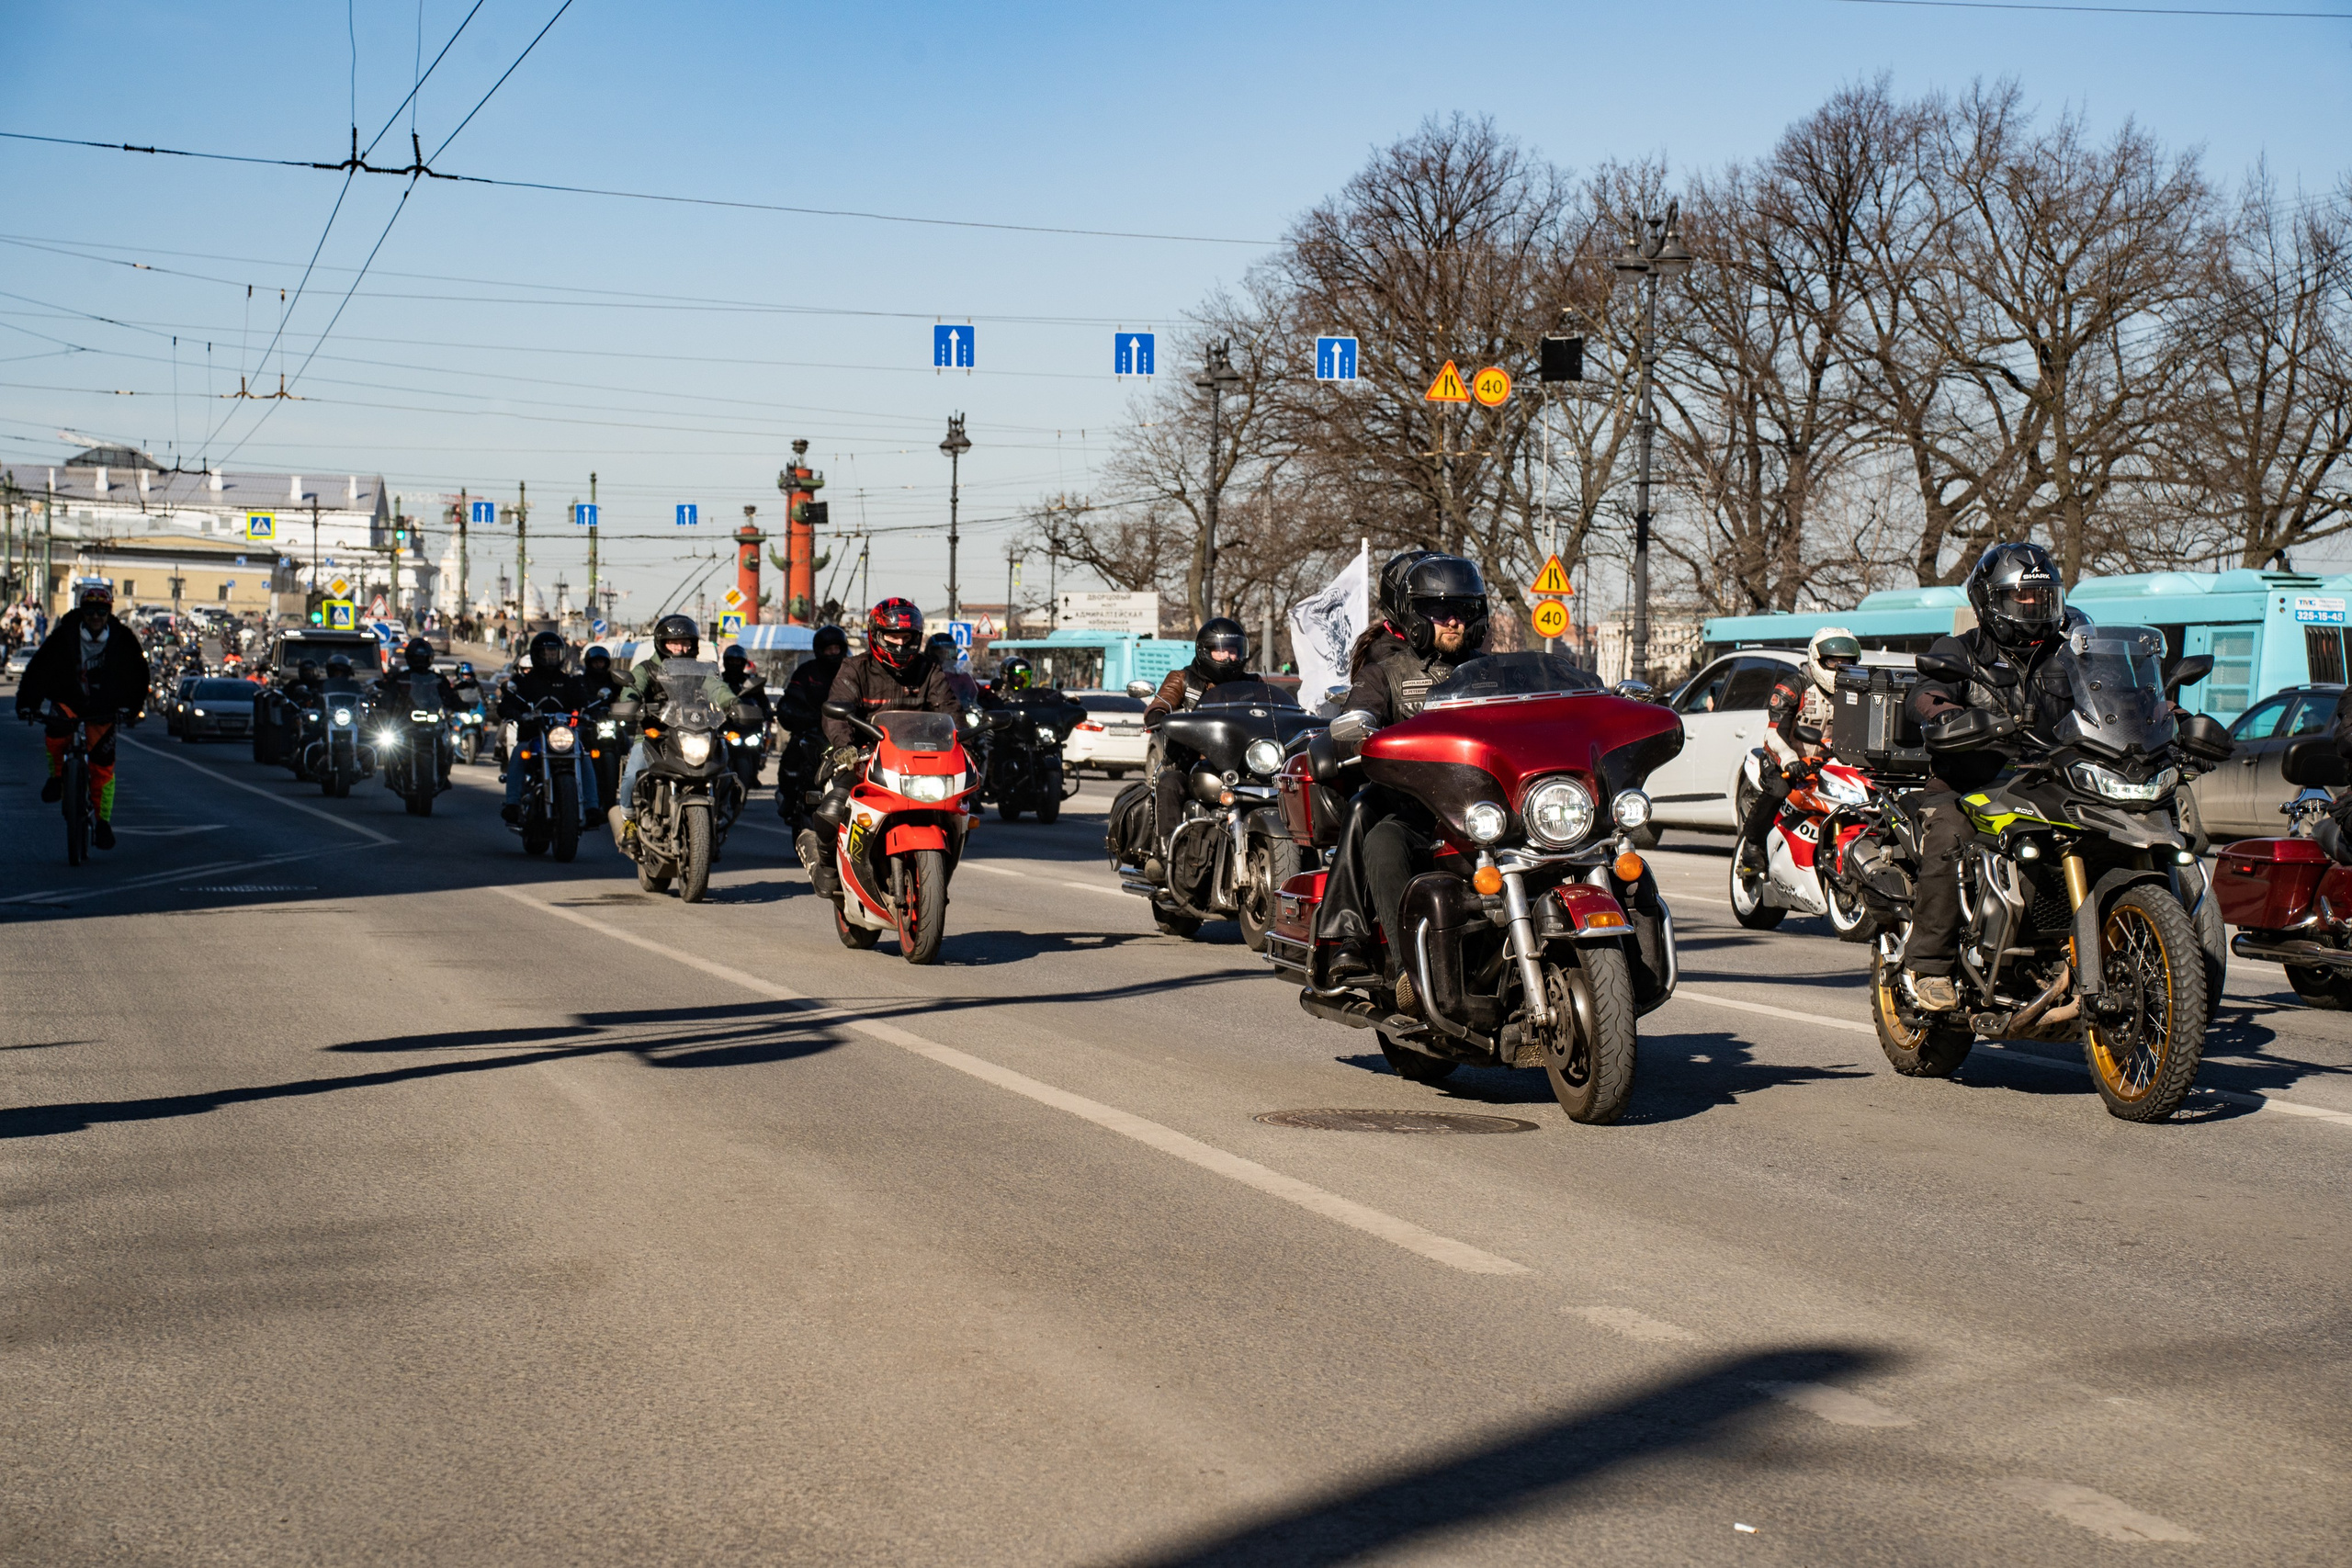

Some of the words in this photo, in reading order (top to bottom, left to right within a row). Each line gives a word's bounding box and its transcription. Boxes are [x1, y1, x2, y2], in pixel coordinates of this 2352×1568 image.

[1481, 379, 1502, 394] 40
[1541, 611, 1562, 626] 40
[2297, 611, 2344, 622] 325-15-45
